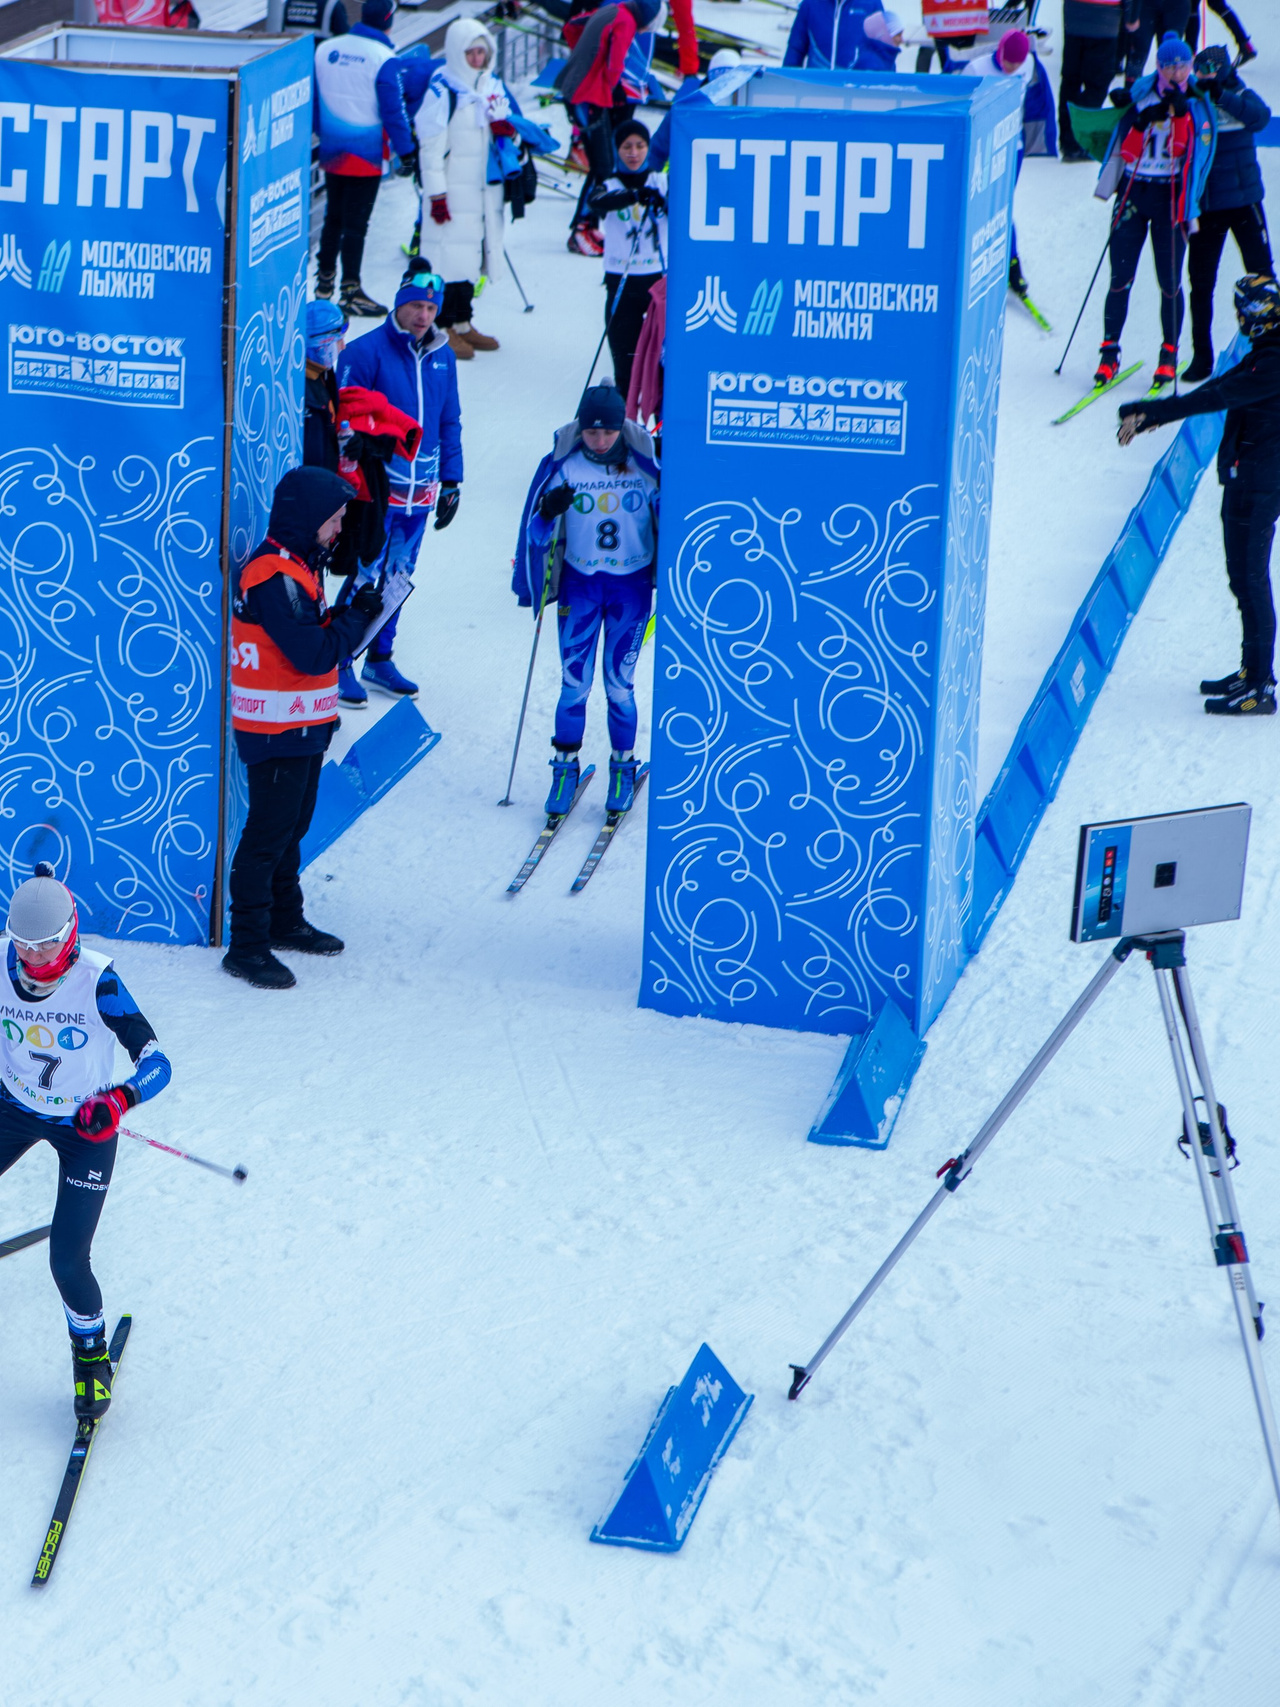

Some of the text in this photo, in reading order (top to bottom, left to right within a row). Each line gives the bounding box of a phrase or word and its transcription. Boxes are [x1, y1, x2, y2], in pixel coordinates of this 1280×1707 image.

[689, 138, 945, 249] СТАРТ
[81, 239, 212, 274] МОСКОВСКАЯ
[78, 269, 155, 300] ЛЫЖНЯ
[793, 279, 939, 313] МОСКОВСКАЯ
[8, 323, 186, 358] ЮГО-ВОСТОК
[792, 309, 874, 341] ЛЫЖНЯ
[708, 371, 907, 402] ЮГО-ВОСТОК
[596, 518, 621, 552] 8
[28, 1050, 62, 1091] 7
[66, 1176, 109, 1191] NORDSK
[34, 1519, 64, 1579] FISCHER
